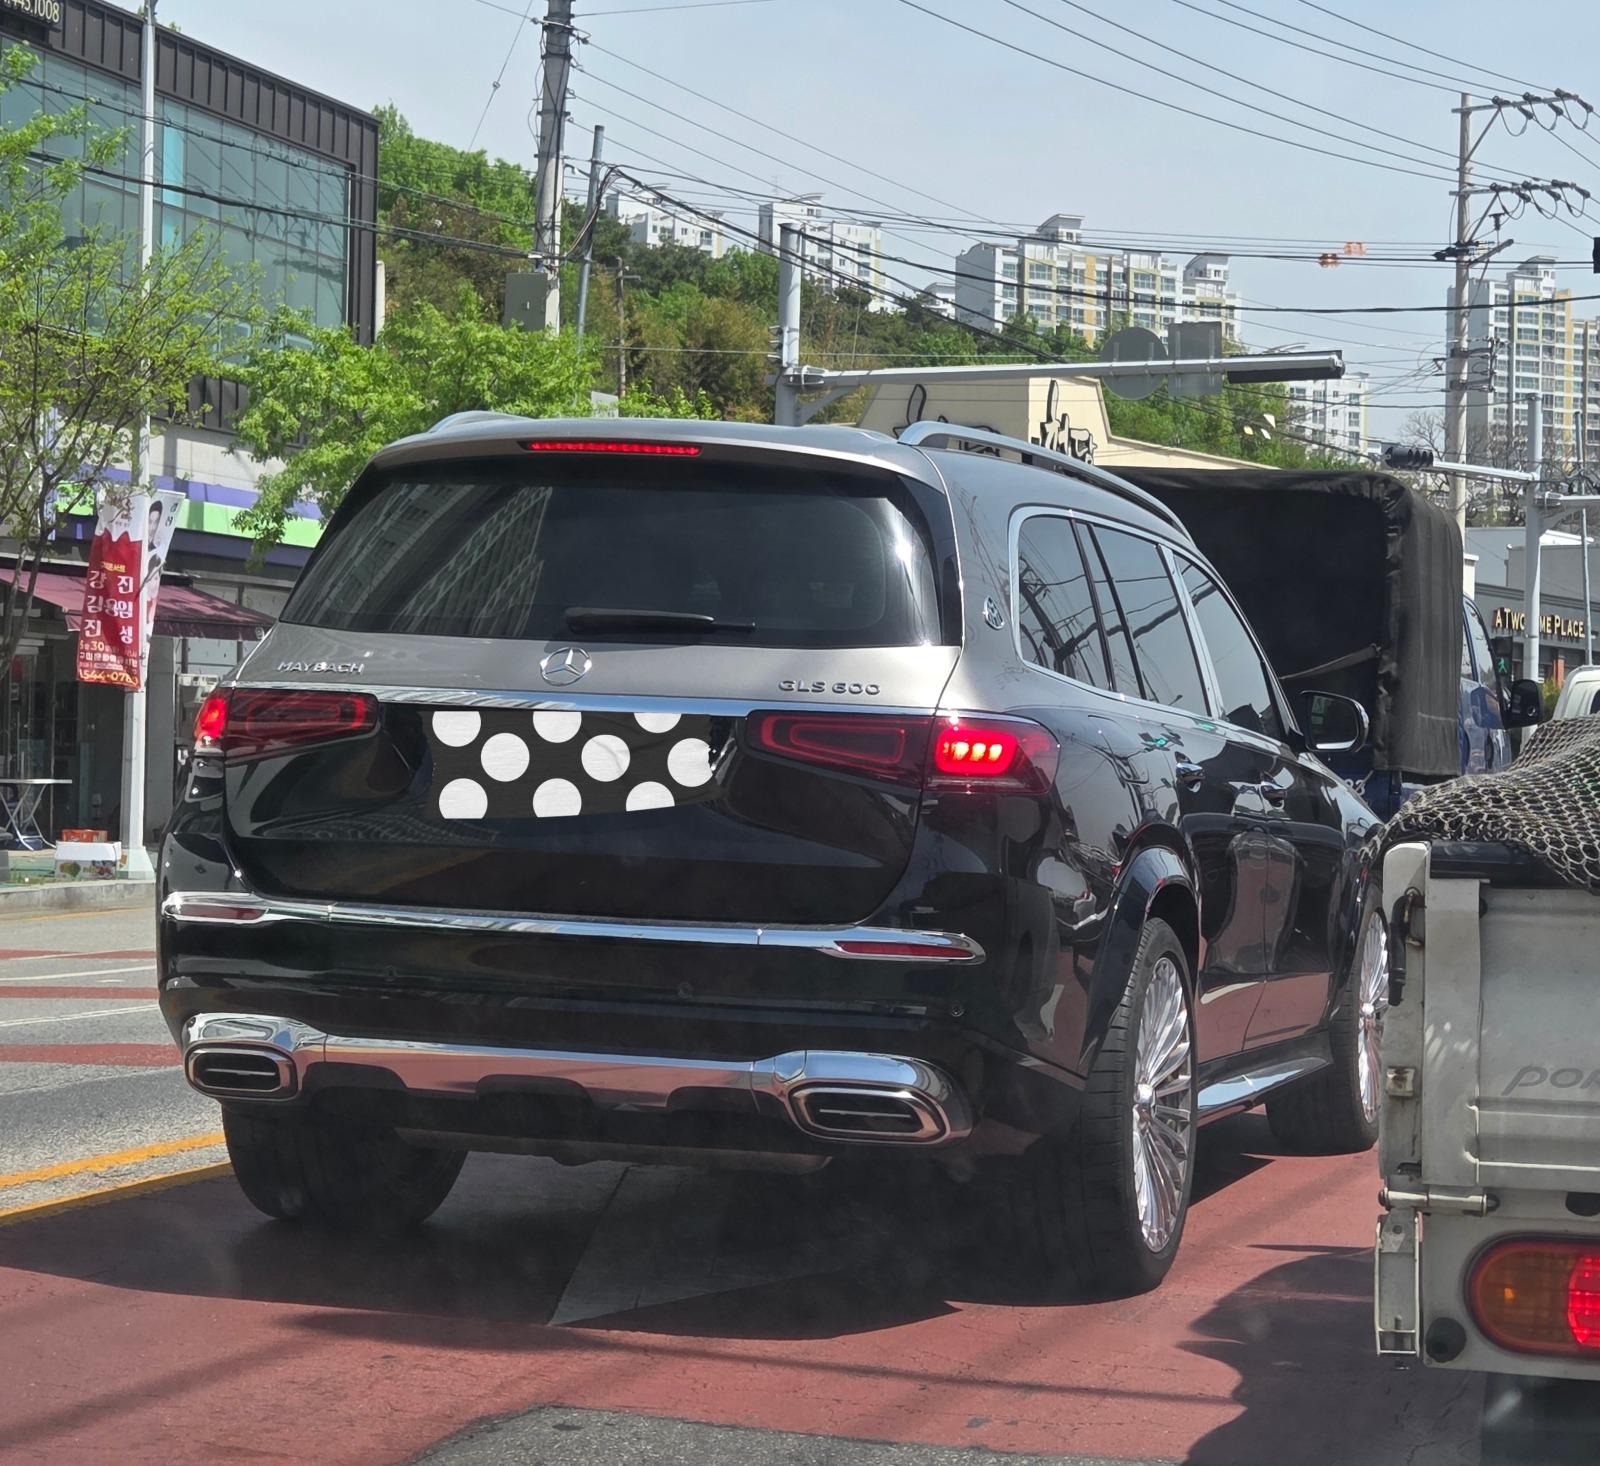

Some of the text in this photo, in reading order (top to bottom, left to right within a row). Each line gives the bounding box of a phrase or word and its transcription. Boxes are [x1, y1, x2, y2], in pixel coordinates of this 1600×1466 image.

[1503, 607, 1552, 635] TWOME
[1554, 614, 1586, 638] PLACE
[276, 661, 365, 674] MAYBACH
[778, 680, 880, 696] GLS 600
